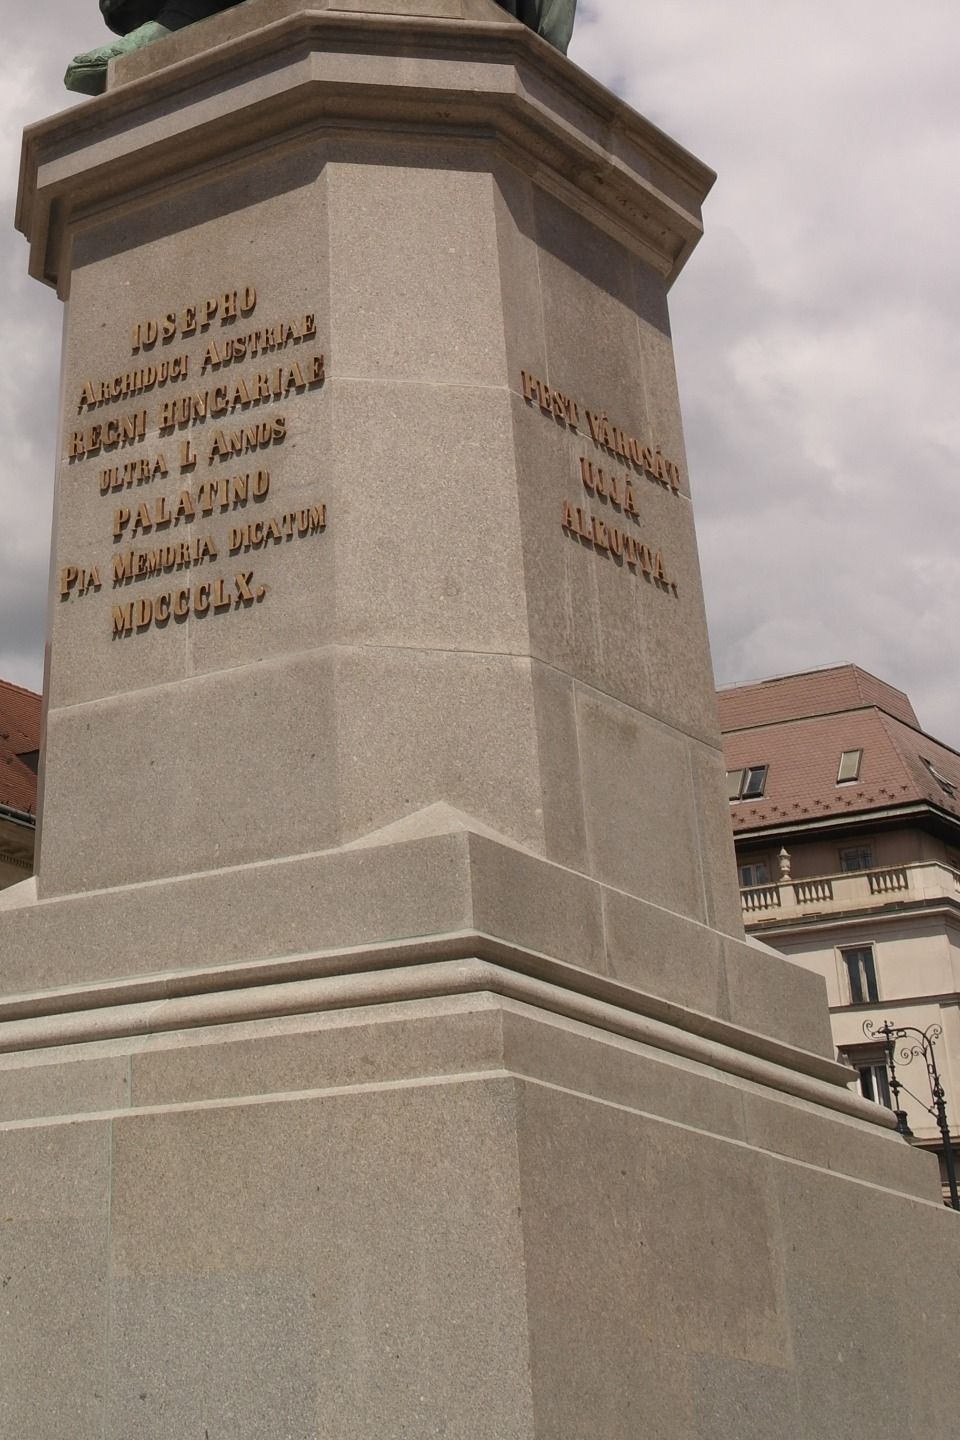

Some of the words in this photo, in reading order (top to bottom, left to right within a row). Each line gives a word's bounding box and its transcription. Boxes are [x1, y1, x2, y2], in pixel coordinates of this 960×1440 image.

[131, 287, 257, 351] IOSEPHO
[79, 355, 189, 407] ARCHIDUCI
[202, 313, 317, 367] AUSTRIAE
[68, 410, 147, 458] REGNI
[159, 354, 325, 429] HUNGARIAE
[520, 370, 580, 430] PEST
[99, 454, 169, 491] ULTRA
[180, 440, 197, 468] L
[209, 417, 287, 459] ANNOS
[112, 469, 270, 537] PALATINO
[60, 565, 102, 596] PIA
[112, 535, 218, 582] MEMORIA
[229, 503, 327, 551] DICATUM
[111, 570, 267, 635] MDCCCLX.
